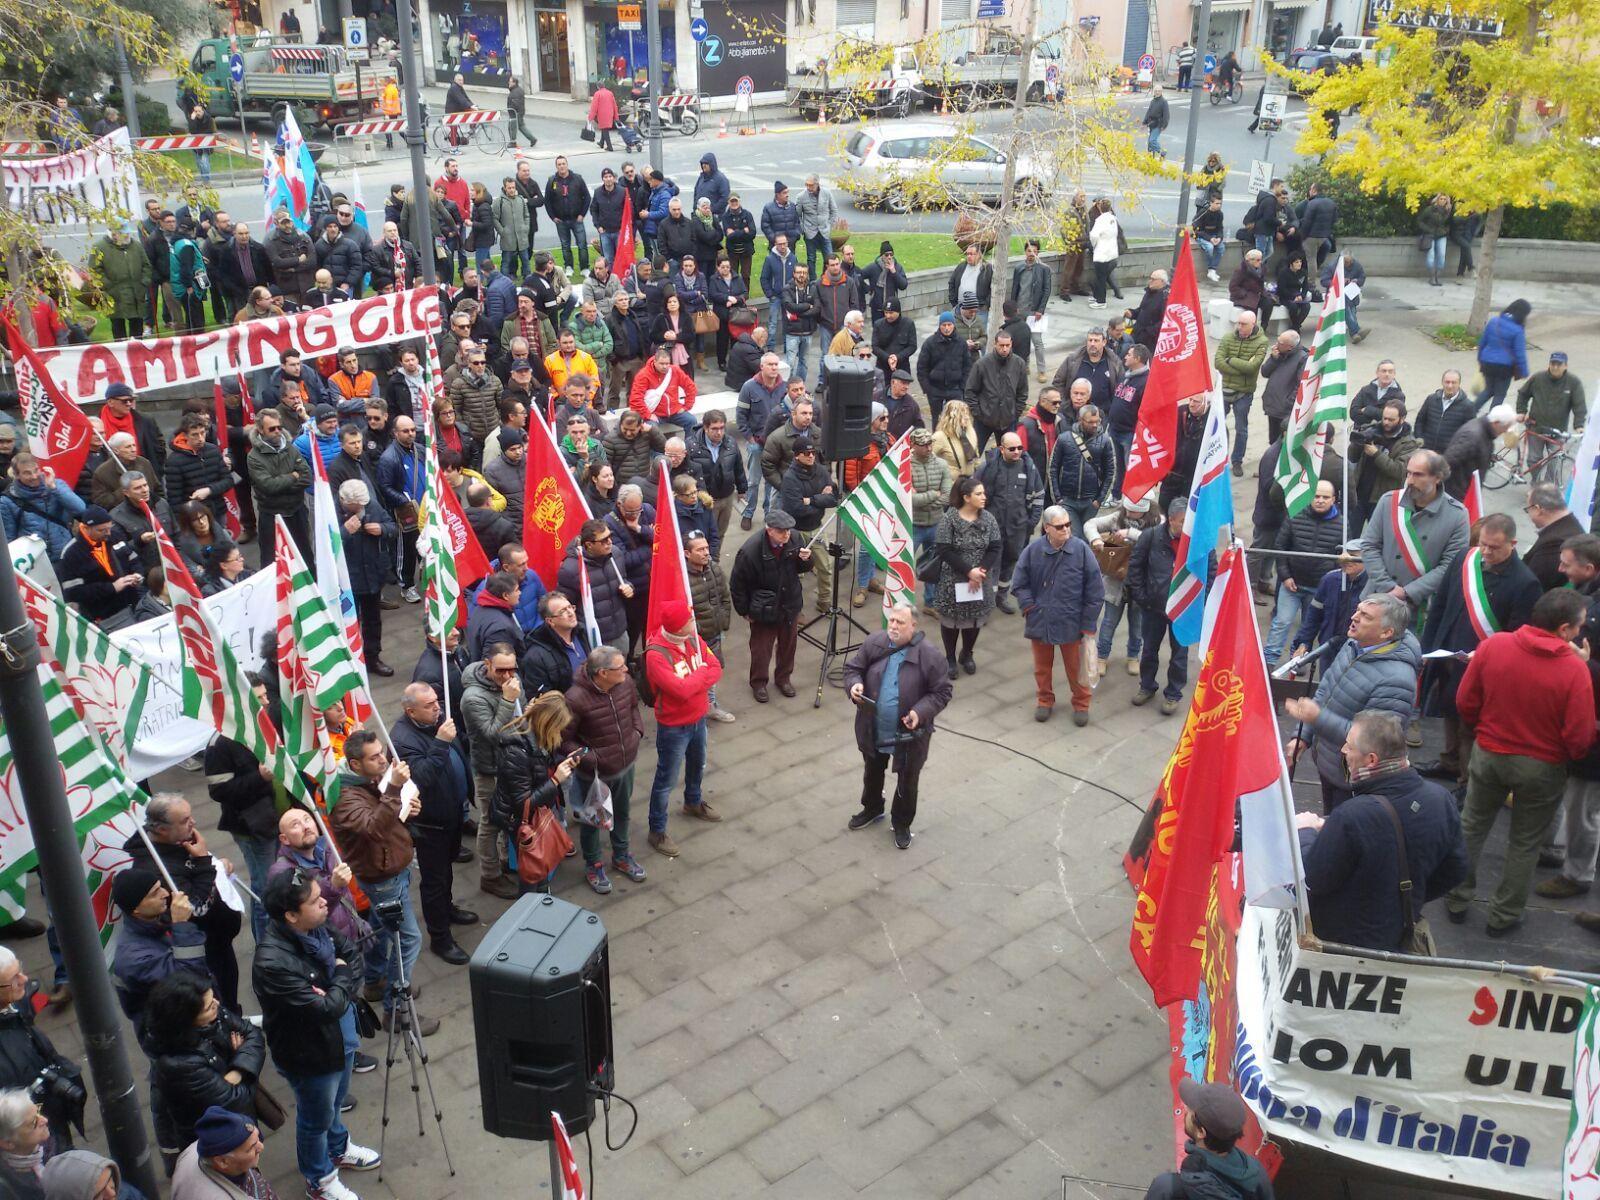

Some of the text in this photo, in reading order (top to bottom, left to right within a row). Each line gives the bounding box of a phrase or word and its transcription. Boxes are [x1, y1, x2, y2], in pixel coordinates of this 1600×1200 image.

[619, 9, 639, 18] TAXI
[705, 39, 720, 62] Z
[1333, 1095, 1531, 1168] d'italia
